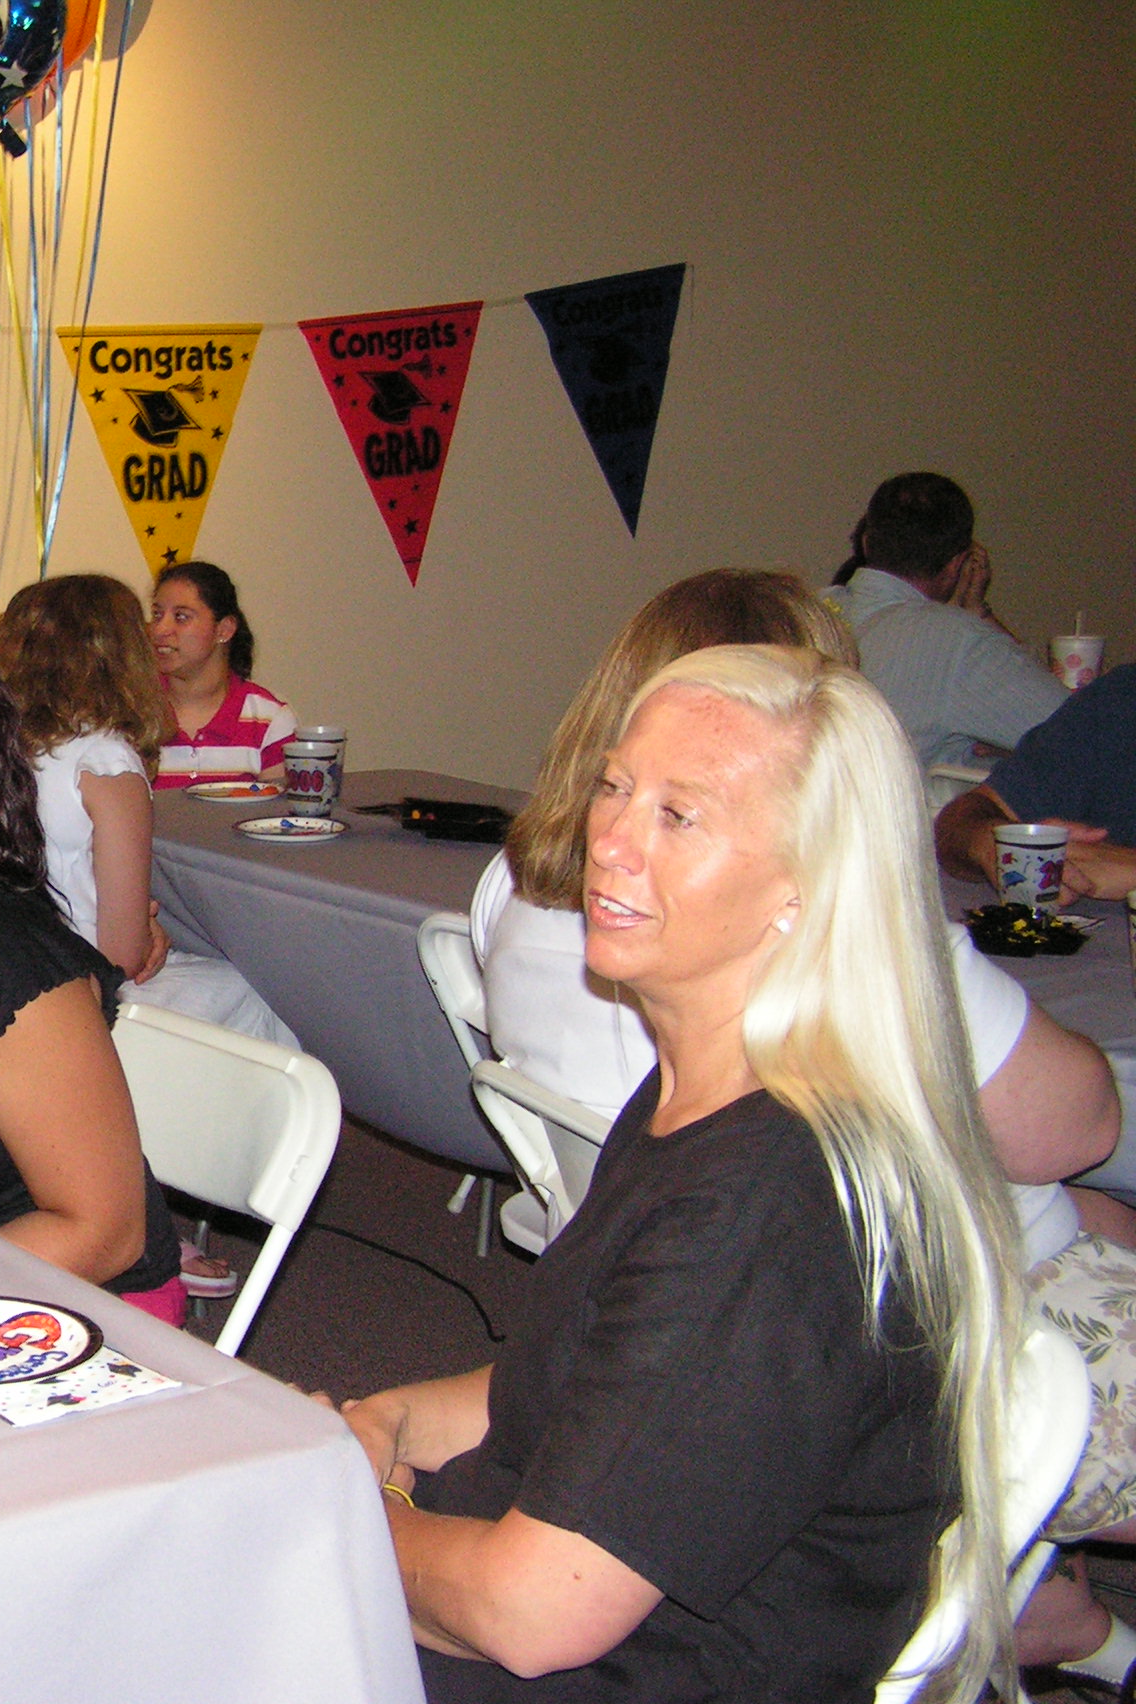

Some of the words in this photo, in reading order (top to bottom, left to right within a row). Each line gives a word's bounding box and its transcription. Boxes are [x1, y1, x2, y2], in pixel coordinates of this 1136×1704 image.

[90, 340, 233, 380] Congrats
[329, 320, 458, 361] Congrats
[123, 451, 208, 503] GRAD
[365, 427, 441, 481] GRAD
